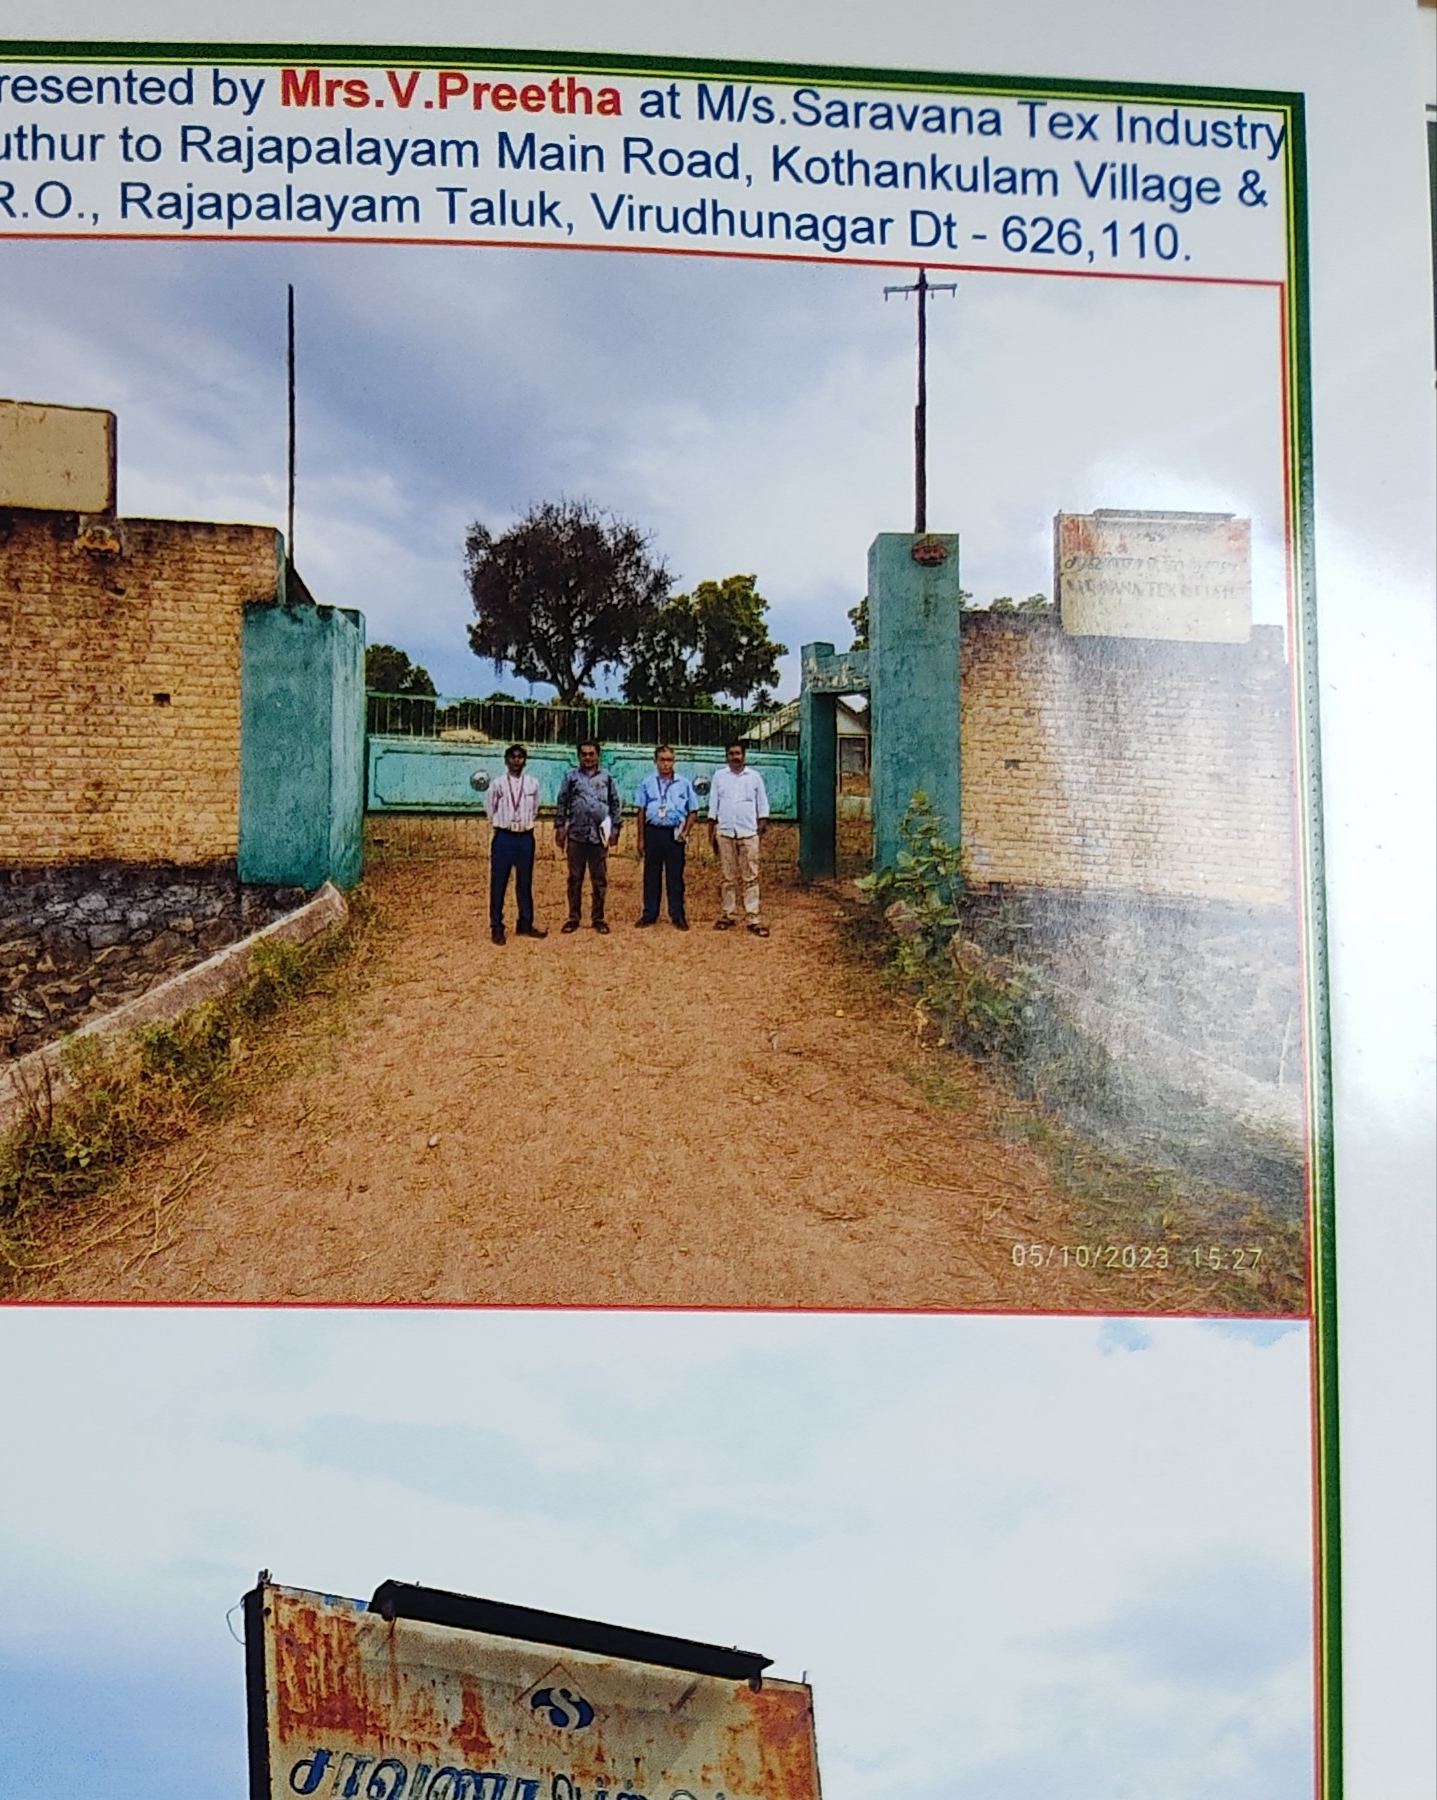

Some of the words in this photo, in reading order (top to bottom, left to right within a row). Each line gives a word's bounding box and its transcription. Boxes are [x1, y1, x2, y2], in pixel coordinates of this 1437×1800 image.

[213, 68, 267, 117] by
[282, 69, 622, 117] Mrs.V.Preetha
[639, 83, 683, 121] at
[697, 83, 1003, 138] M/s.Saravana
[1018, 100, 1101, 143] Tex
[1116, 106, 1285, 160] Industry
[121, 127, 163, 162] to
[181, 124, 480, 177] Rajapalayam
[498, 131, 606, 174] Main
[623, 136, 754, 187] Road,
[772, 144, 1060, 198] Kothankulam
[1074, 160, 1223, 215] Village
[1237, 168, 1270, 209] &
[120, 182, 421, 233] Rajapalayam
[438, 186, 575, 234] Taluk,
[591, 192, 896, 254] Virudhunagar
[910, 209, 959, 251] Dt
[1002, 215, 1192, 265] 626,110.
